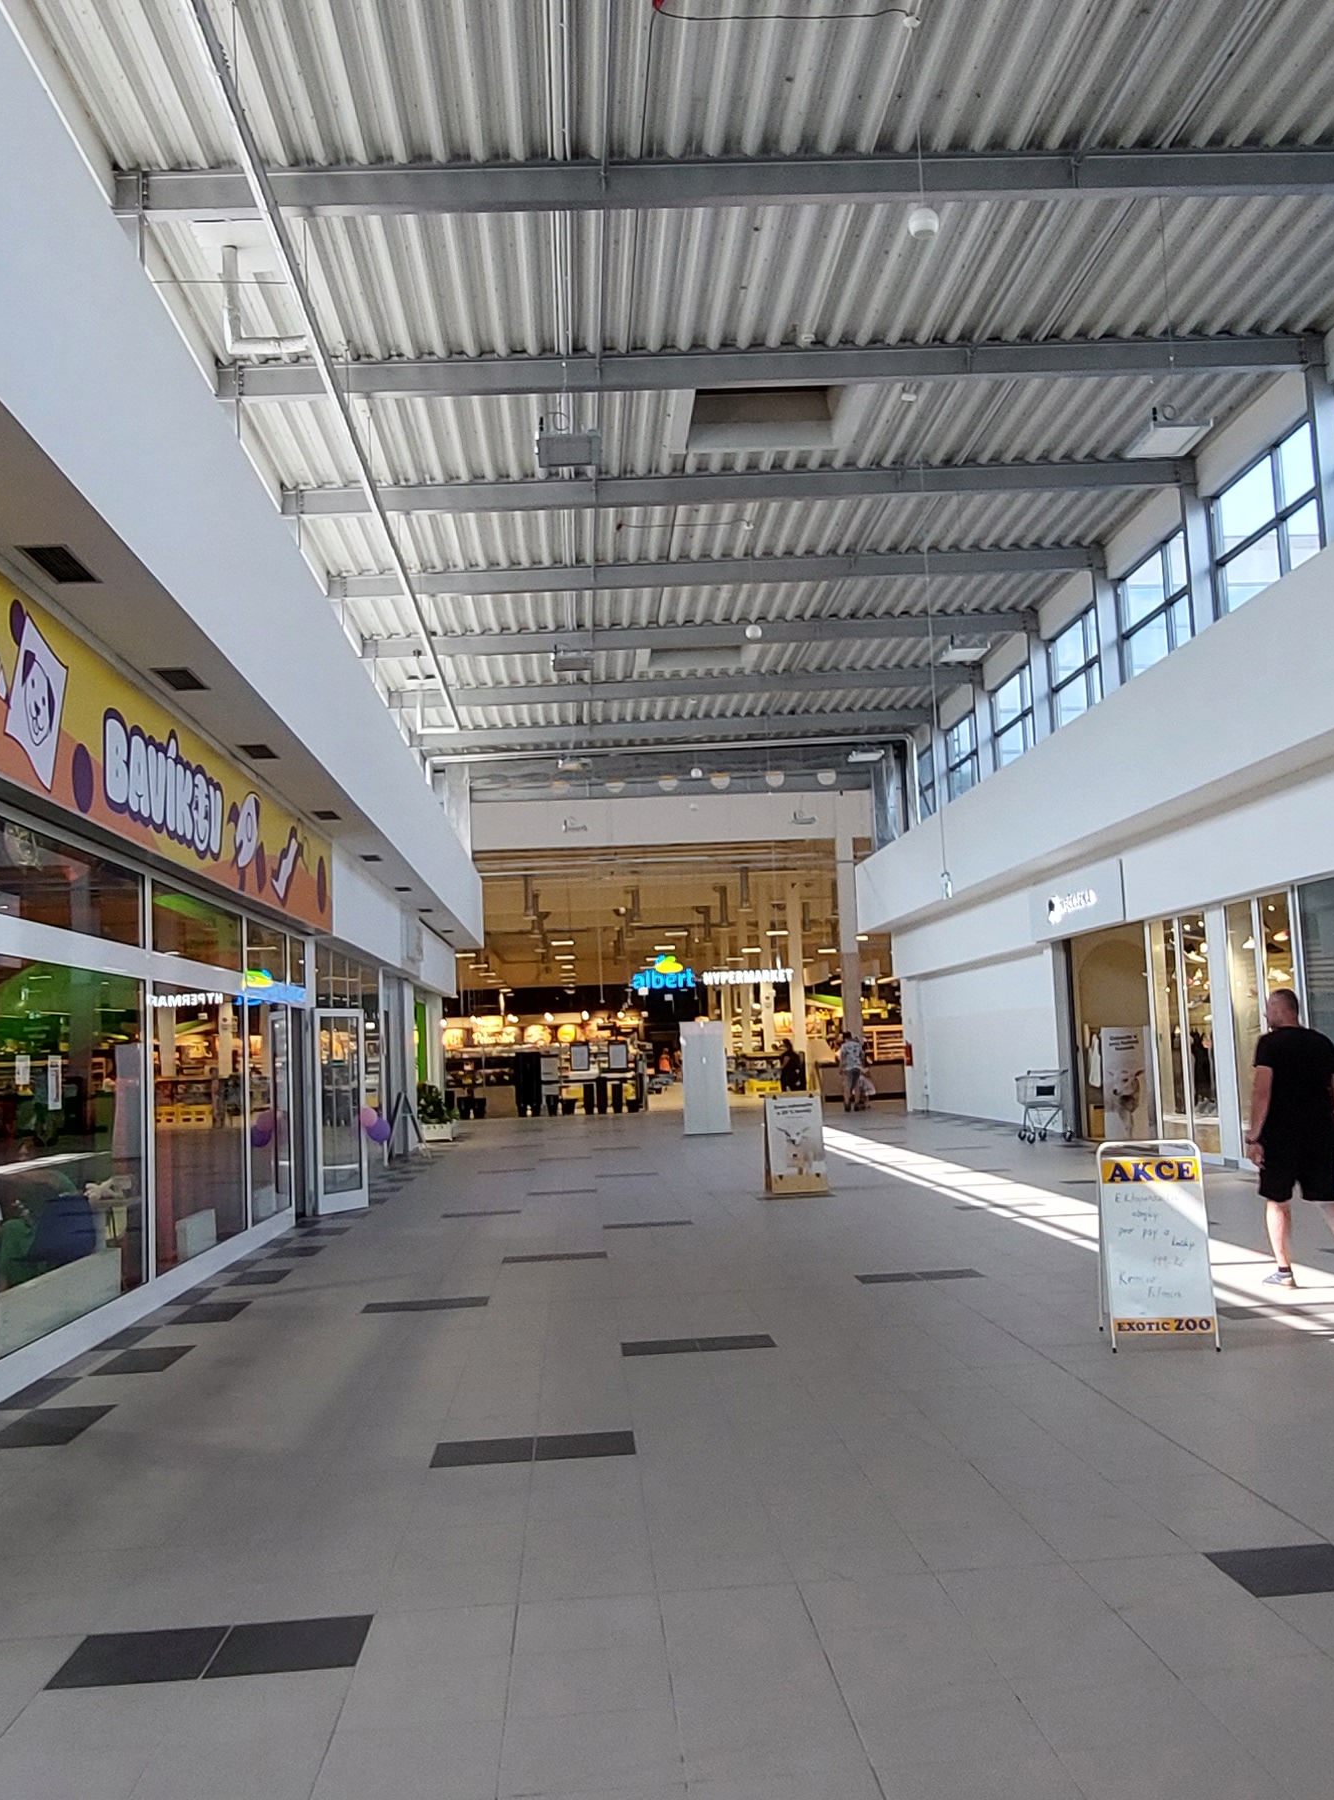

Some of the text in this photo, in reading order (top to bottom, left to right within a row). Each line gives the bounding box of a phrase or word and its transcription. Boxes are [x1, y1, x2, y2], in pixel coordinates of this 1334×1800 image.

[632, 967, 794, 989] albert HYPERMARKET
[1107, 1161, 1196, 1182] AKCE
[1117, 1318, 1211, 1332] EXOTIC ZOO
